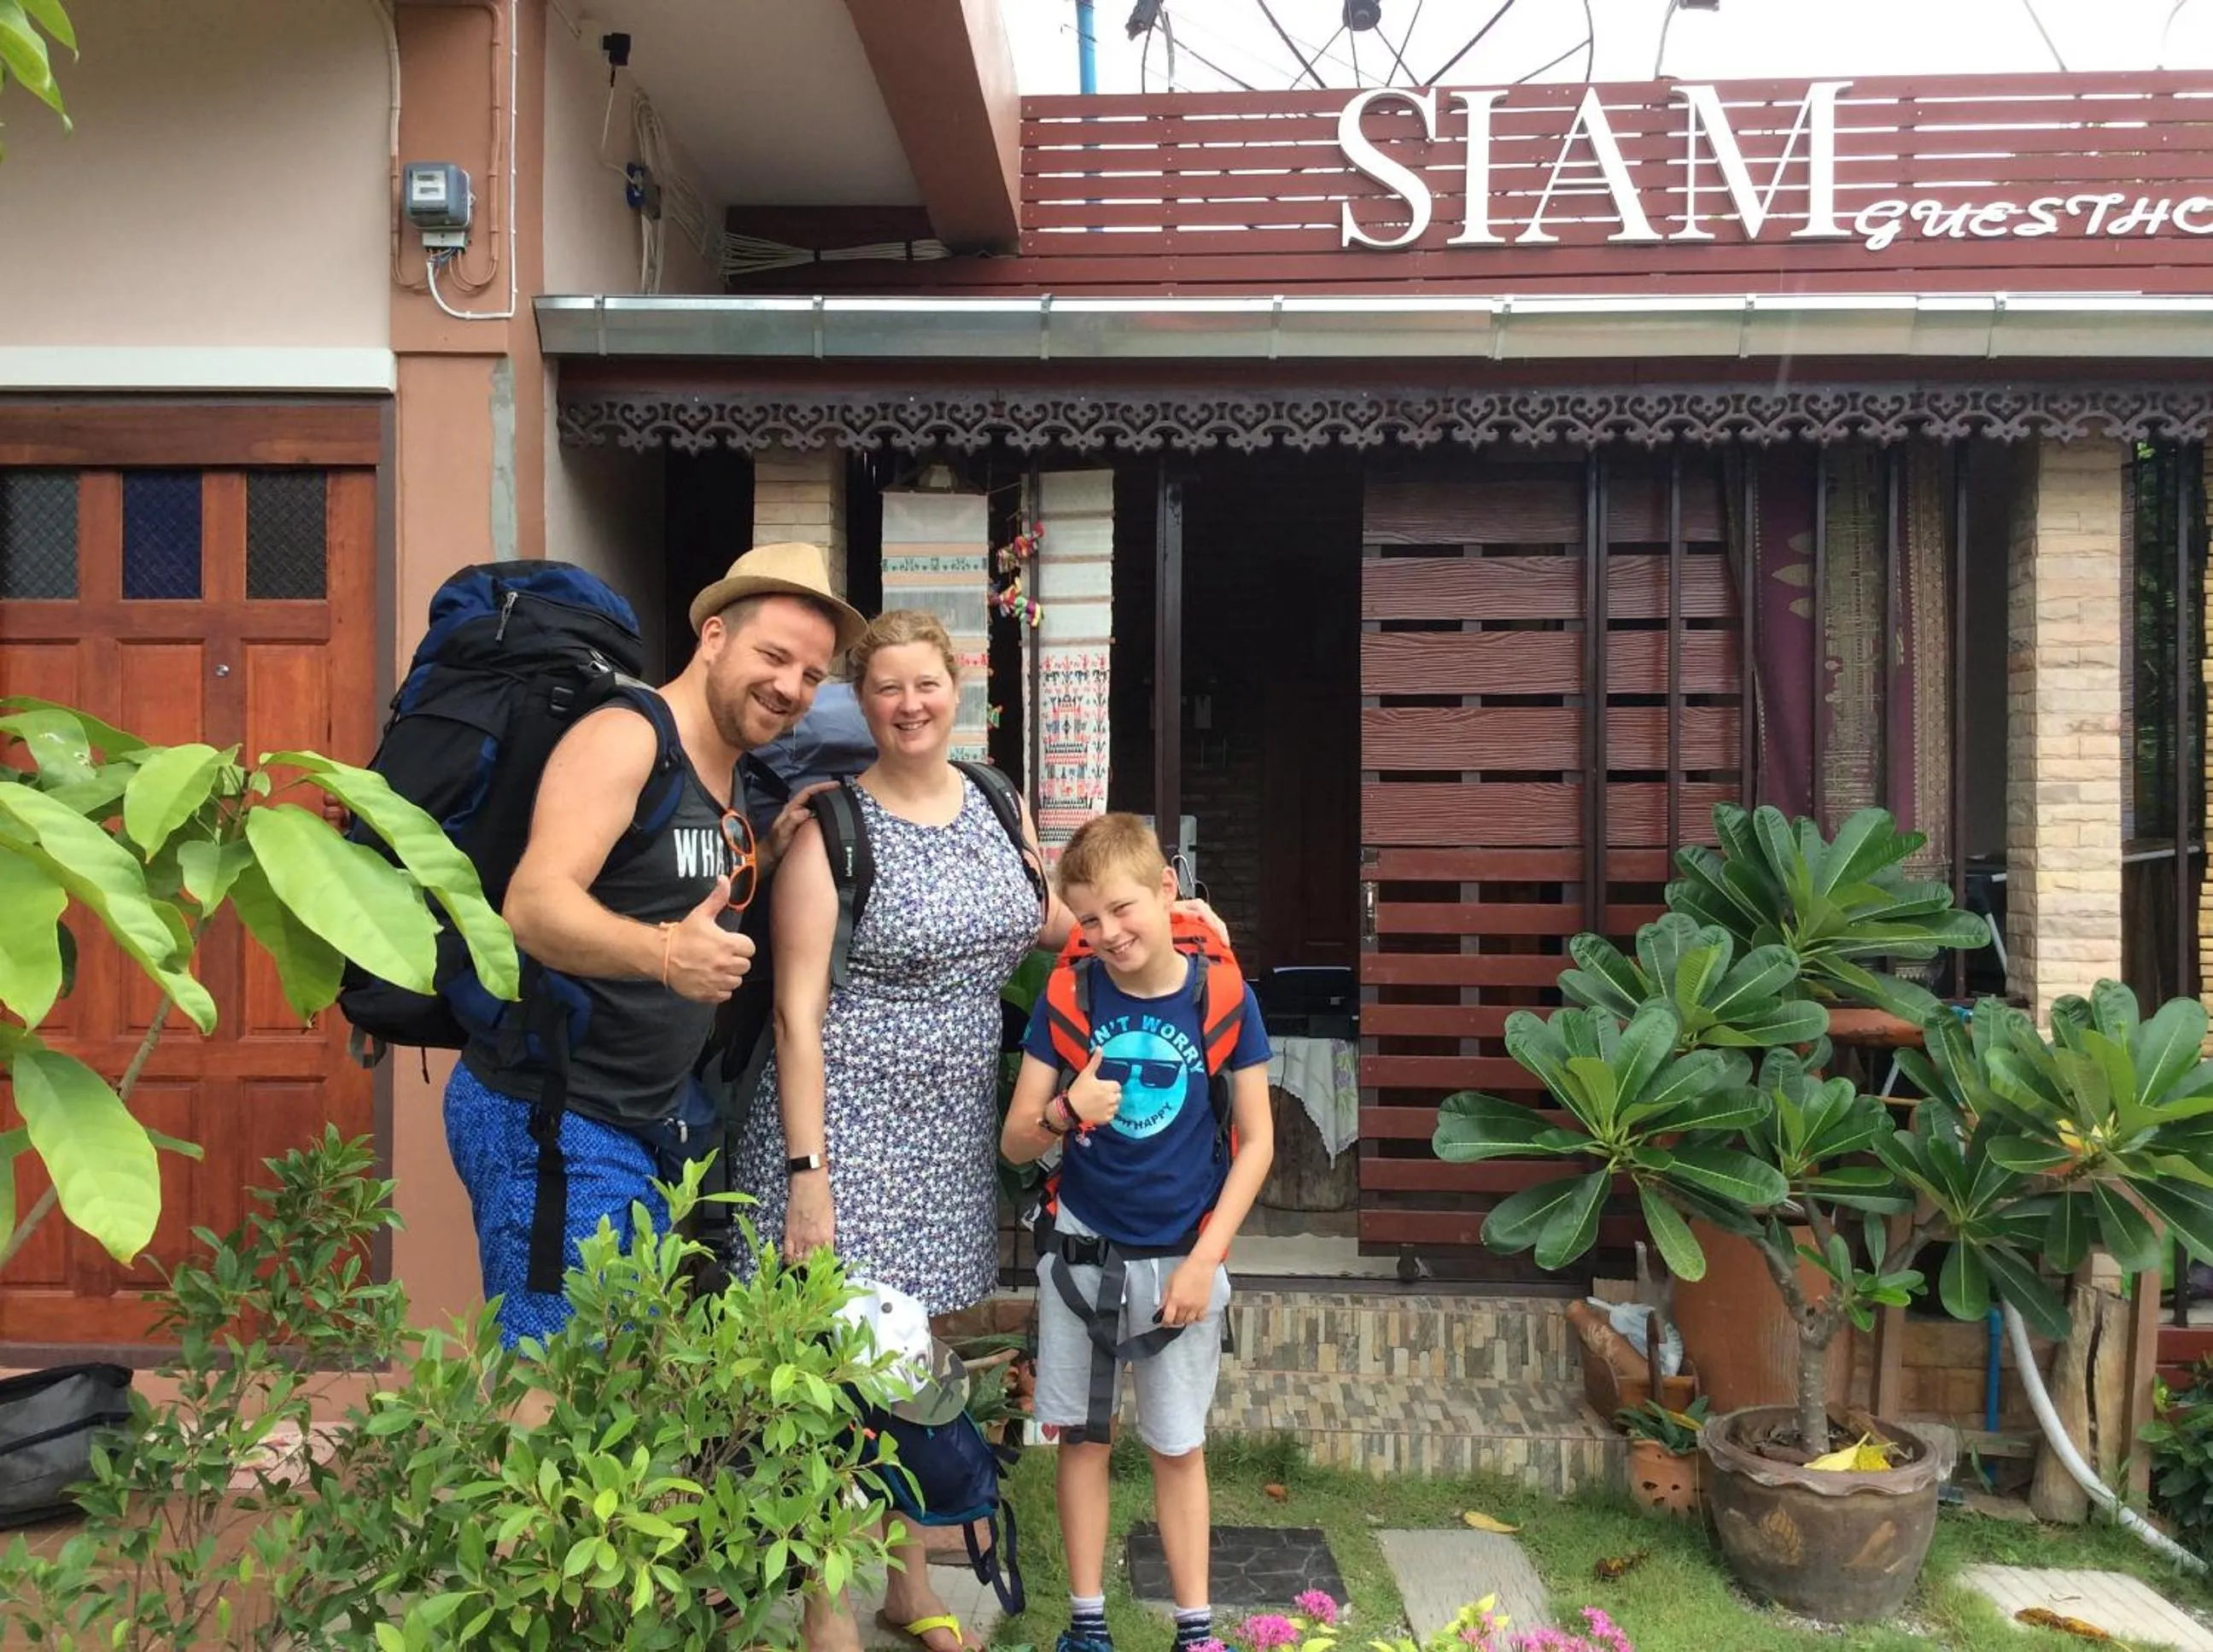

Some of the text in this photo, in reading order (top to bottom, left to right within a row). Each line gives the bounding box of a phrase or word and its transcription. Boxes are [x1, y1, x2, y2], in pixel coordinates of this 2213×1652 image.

[1337, 80, 1856, 249] SIAM
[1089, 1014, 1205, 1073] N'T WORRY
[1134, 1101, 1173, 1130] HAPPY
